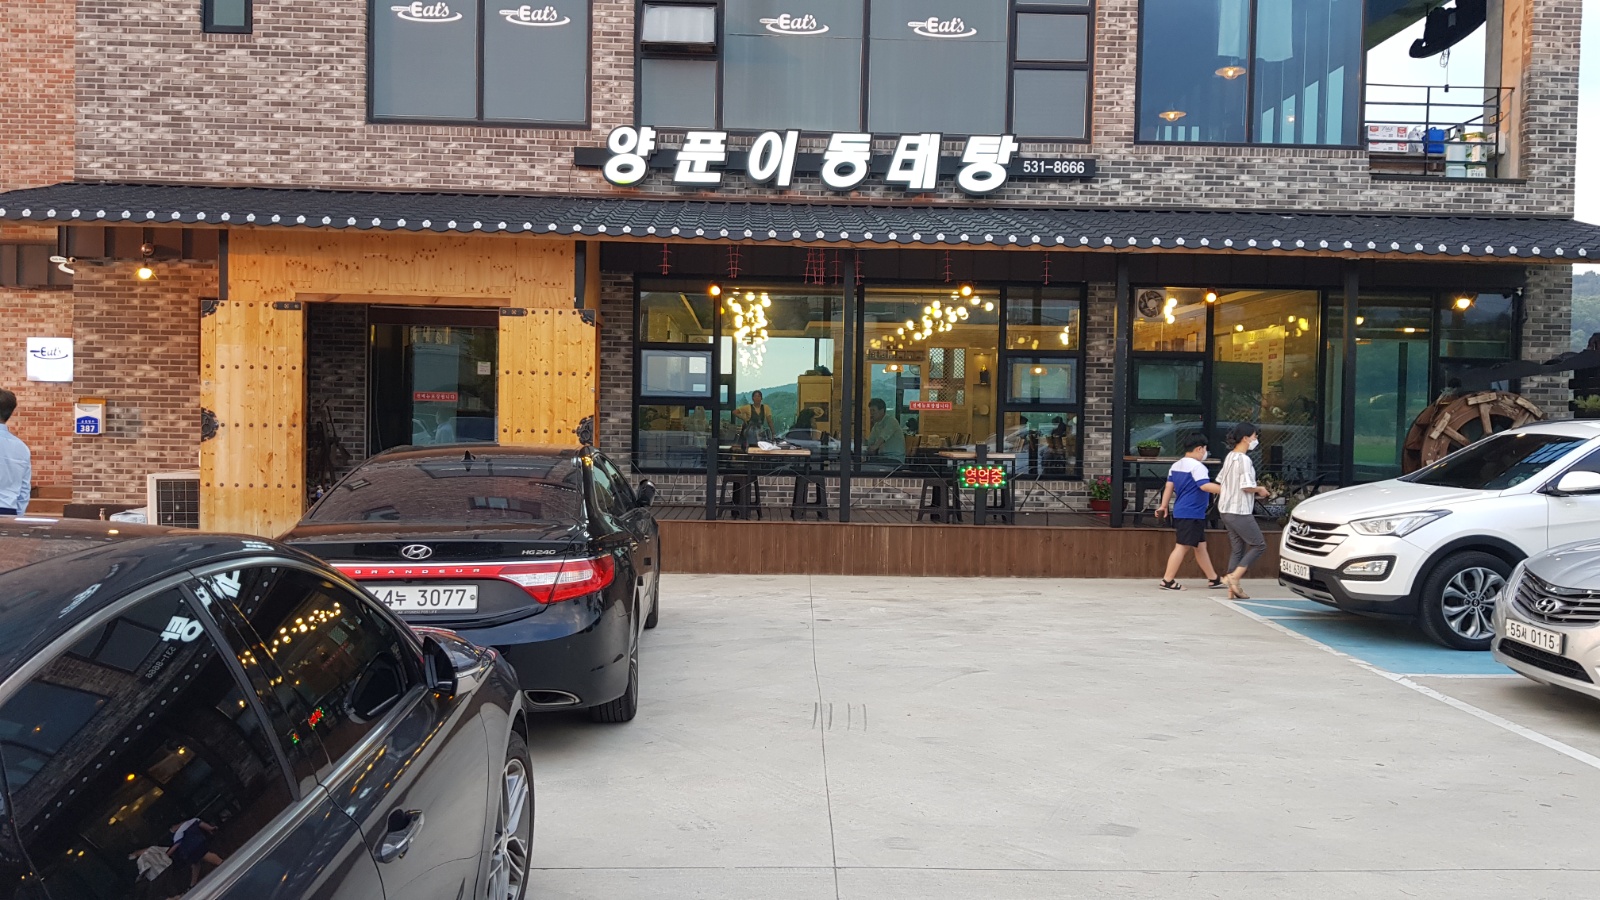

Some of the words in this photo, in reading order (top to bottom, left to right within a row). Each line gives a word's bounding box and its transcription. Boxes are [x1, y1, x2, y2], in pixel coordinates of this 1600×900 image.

[411, 1, 450, 17] Eat's
[519, 5, 558, 21] Eat's
[779, 13, 817, 30] Eat's
[927, 16, 965, 33] Eat's
[1022, 160, 1085, 175] 531-8666
[965, 468, 1002, 485] 영업중
[417, 589, 467, 607] 3077
[1531, 629, 1555, 649] 0115
